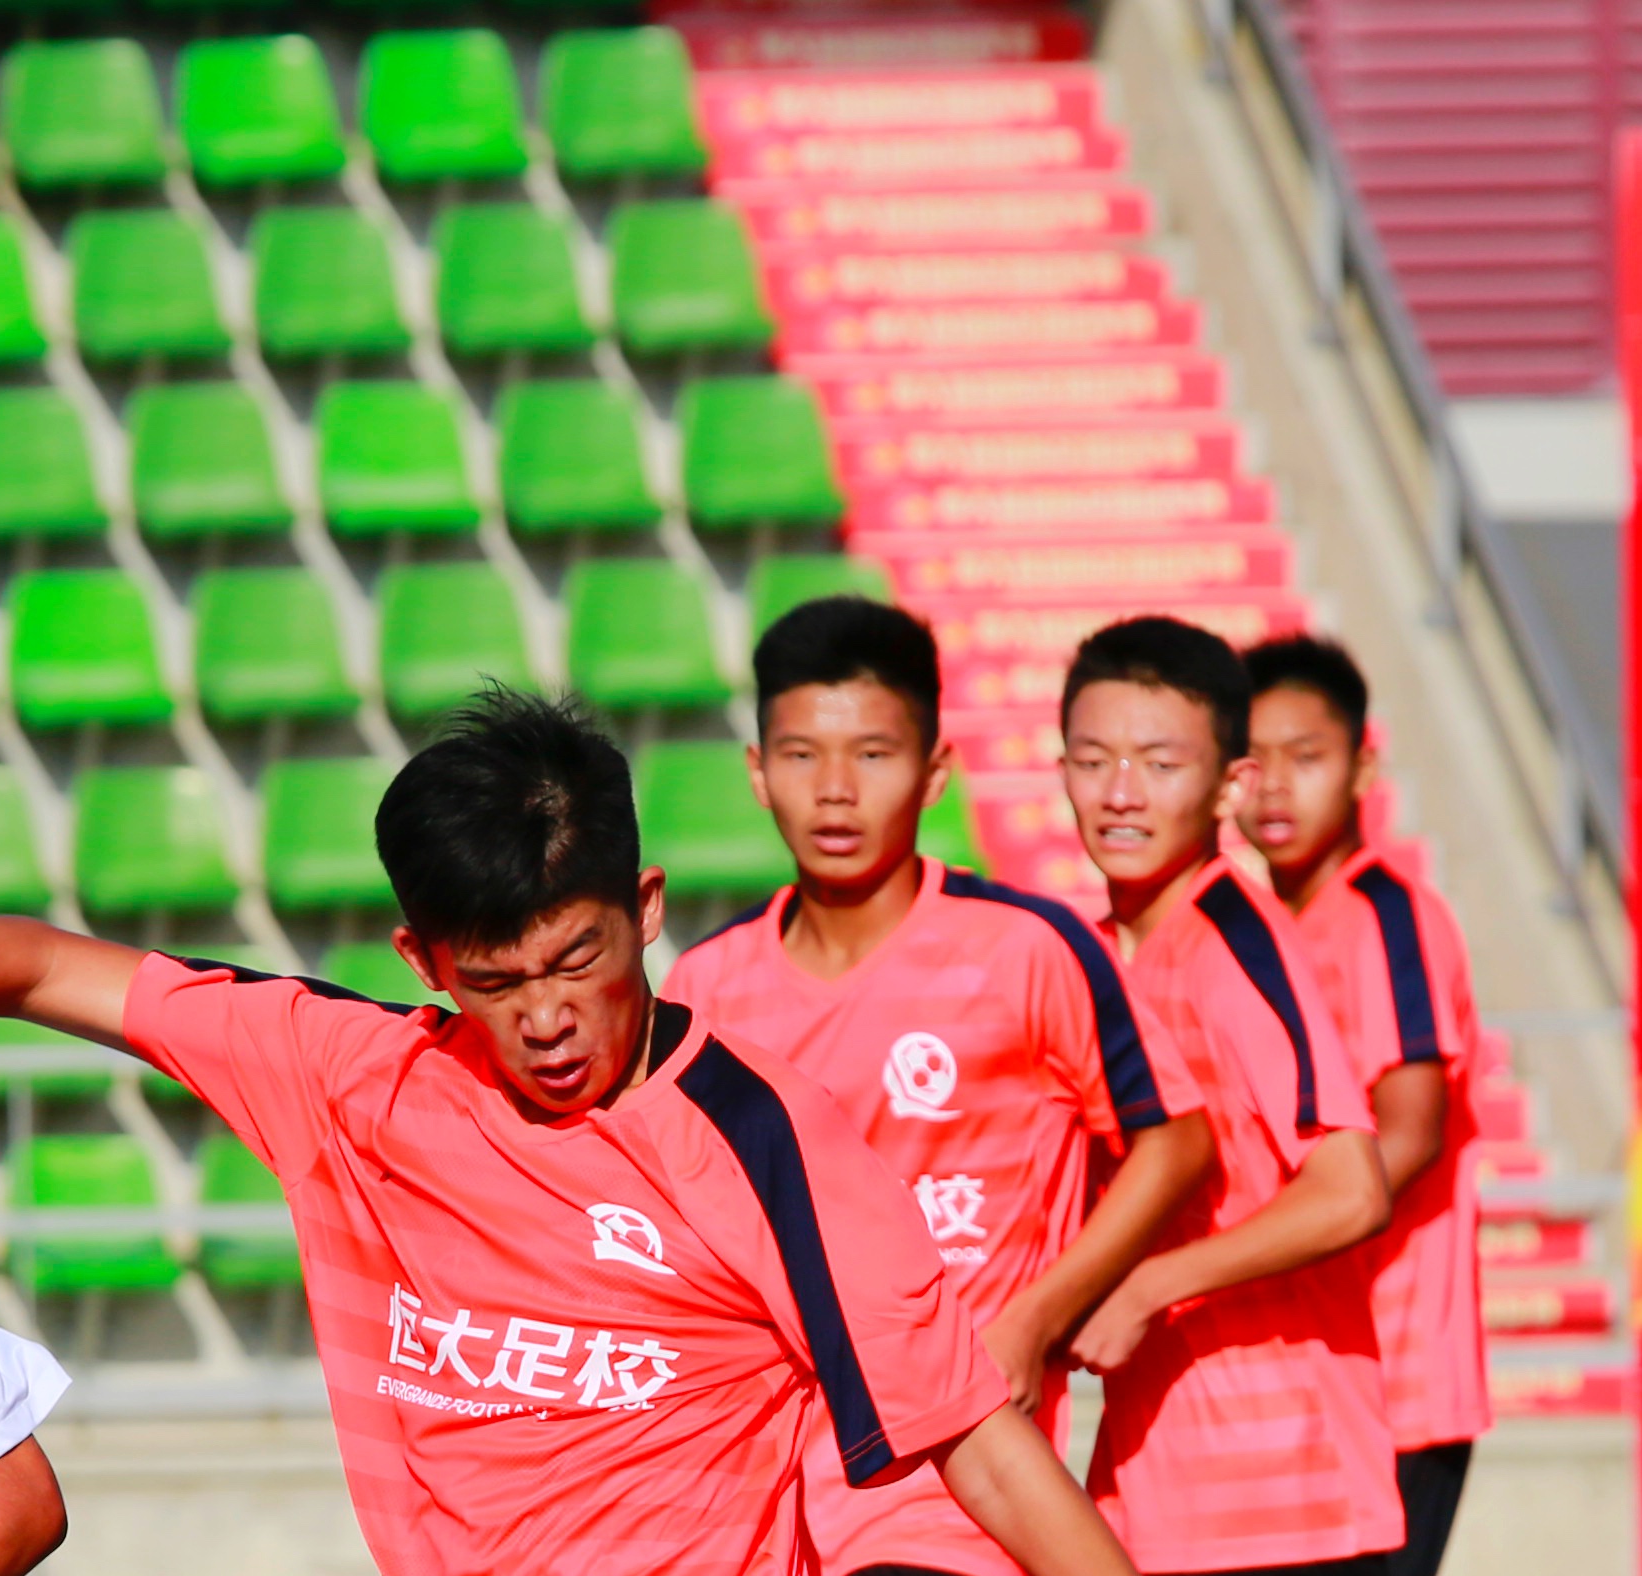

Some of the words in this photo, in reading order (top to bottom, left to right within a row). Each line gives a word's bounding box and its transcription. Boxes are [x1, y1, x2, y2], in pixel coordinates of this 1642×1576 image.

[387, 1281, 681, 1409] 恒大足校
[376, 1374, 453, 1410] EVERGRANDE
[444, 1397, 548, 1420] FOOTBA
